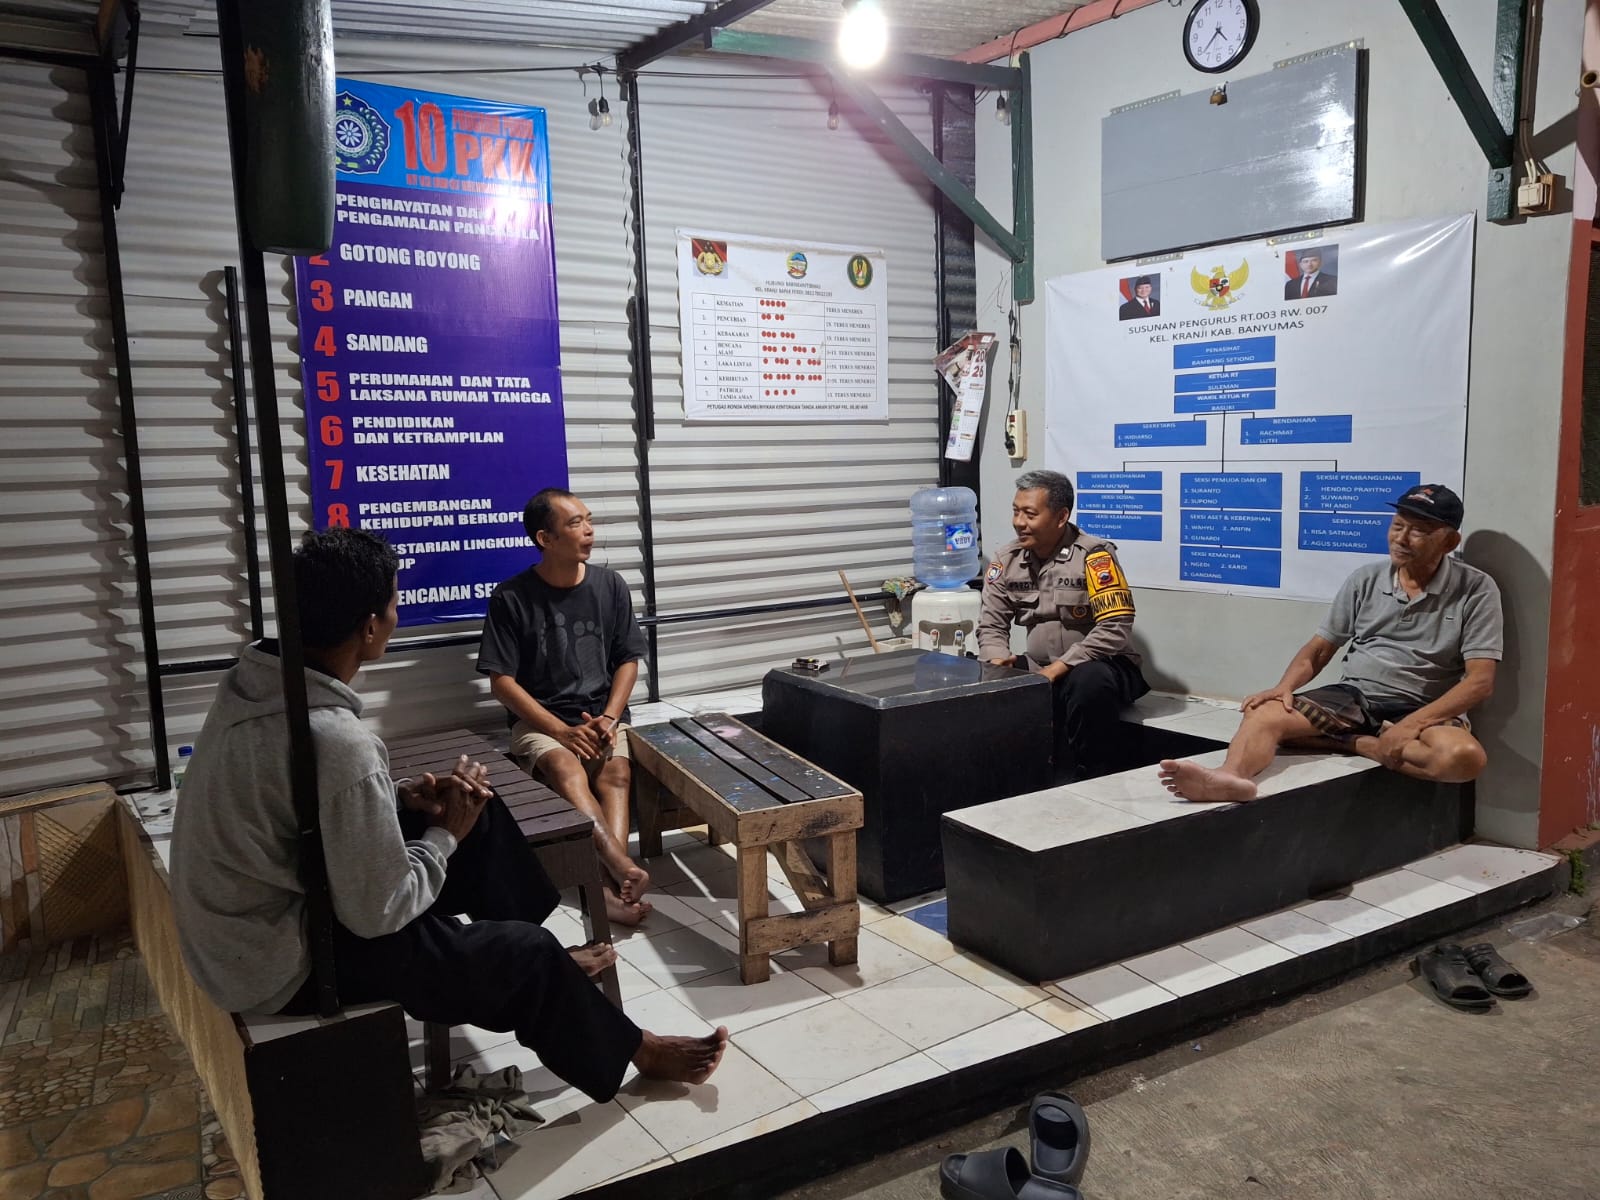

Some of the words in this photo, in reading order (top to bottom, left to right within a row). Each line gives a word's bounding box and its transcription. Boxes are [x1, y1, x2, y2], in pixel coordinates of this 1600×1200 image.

[1235, 5, 1241, 15] 2
[1240, 19, 1245, 29] 3
[1228, 45, 1234, 55] 5
[394, 100, 447, 174] 10
[453, 132, 537, 184] PKK
[336, 193, 452, 217] PENGHAYATAN
[337, 210, 450, 233] PENGAMALAN
[340, 243, 410, 266] GOTONG
[415, 252, 481, 271] ROYONG
[311, 279, 334, 311] 3
[343, 289, 413, 309] PANGAN
[1128, 322, 1177, 335] SUSUNAN
[1179, 314, 1238, 329] PENGURUS
[1240, 310, 1276, 323] RT.003
[1280, 308, 1302, 319] RW.
[1305, 305, 1328, 316] 007
[314, 326, 337, 356] 4
[1149, 333, 1169, 345] KEL.
[1172, 328, 1208, 341] KRANJI
[1210, 326, 1235, 338] KAB.
[1238, 320, 1305, 335] BANYUMAS
[346, 334, 428, 354] SANDANG
[1205, 345, 1240, 353] PENASIHAT
[1191, 358, 1225, 366] BAMBANG
[1226, 355, 1255, 363] SETIONO
[316, 371, 340, 402] 5
[349, 373, 453, 387] PERUMAHAN
[460, 375, 492, 388] DAN
[496, 377, 531, 388] TATA
[351, 389, 427, 402] LAKSANA
[431, 390, 488, 402] RUMAH
[492, 391, 551, 404] TANGGA
[320, 415, 343, 446] 6
[353, 416, 454, 429] PENDIDIKAN
[1272, 416, 1317, 425] BENDAHARA
[354, 432, 389, 444] DAN
[393, 432, 504, 444] KETRAMPILAN
[325, 459, 344, 490] 7
[356, 464, 450, 482] KESEHATAN
[328, 503, 350, 529] 8
[359, 499, 492, 515] PENGEMBANGAN
[360, 516, 455, 530] KEHIDUPAN
[392, 540, 461, 554] ESTARIAN
[463, 535, 536, 550] LINGKUNG
[1332, 541, 1368, 549] SUNARSO
[398, 585, 471, 606] ENCANAN
[474, 582, 499, 598] SE
